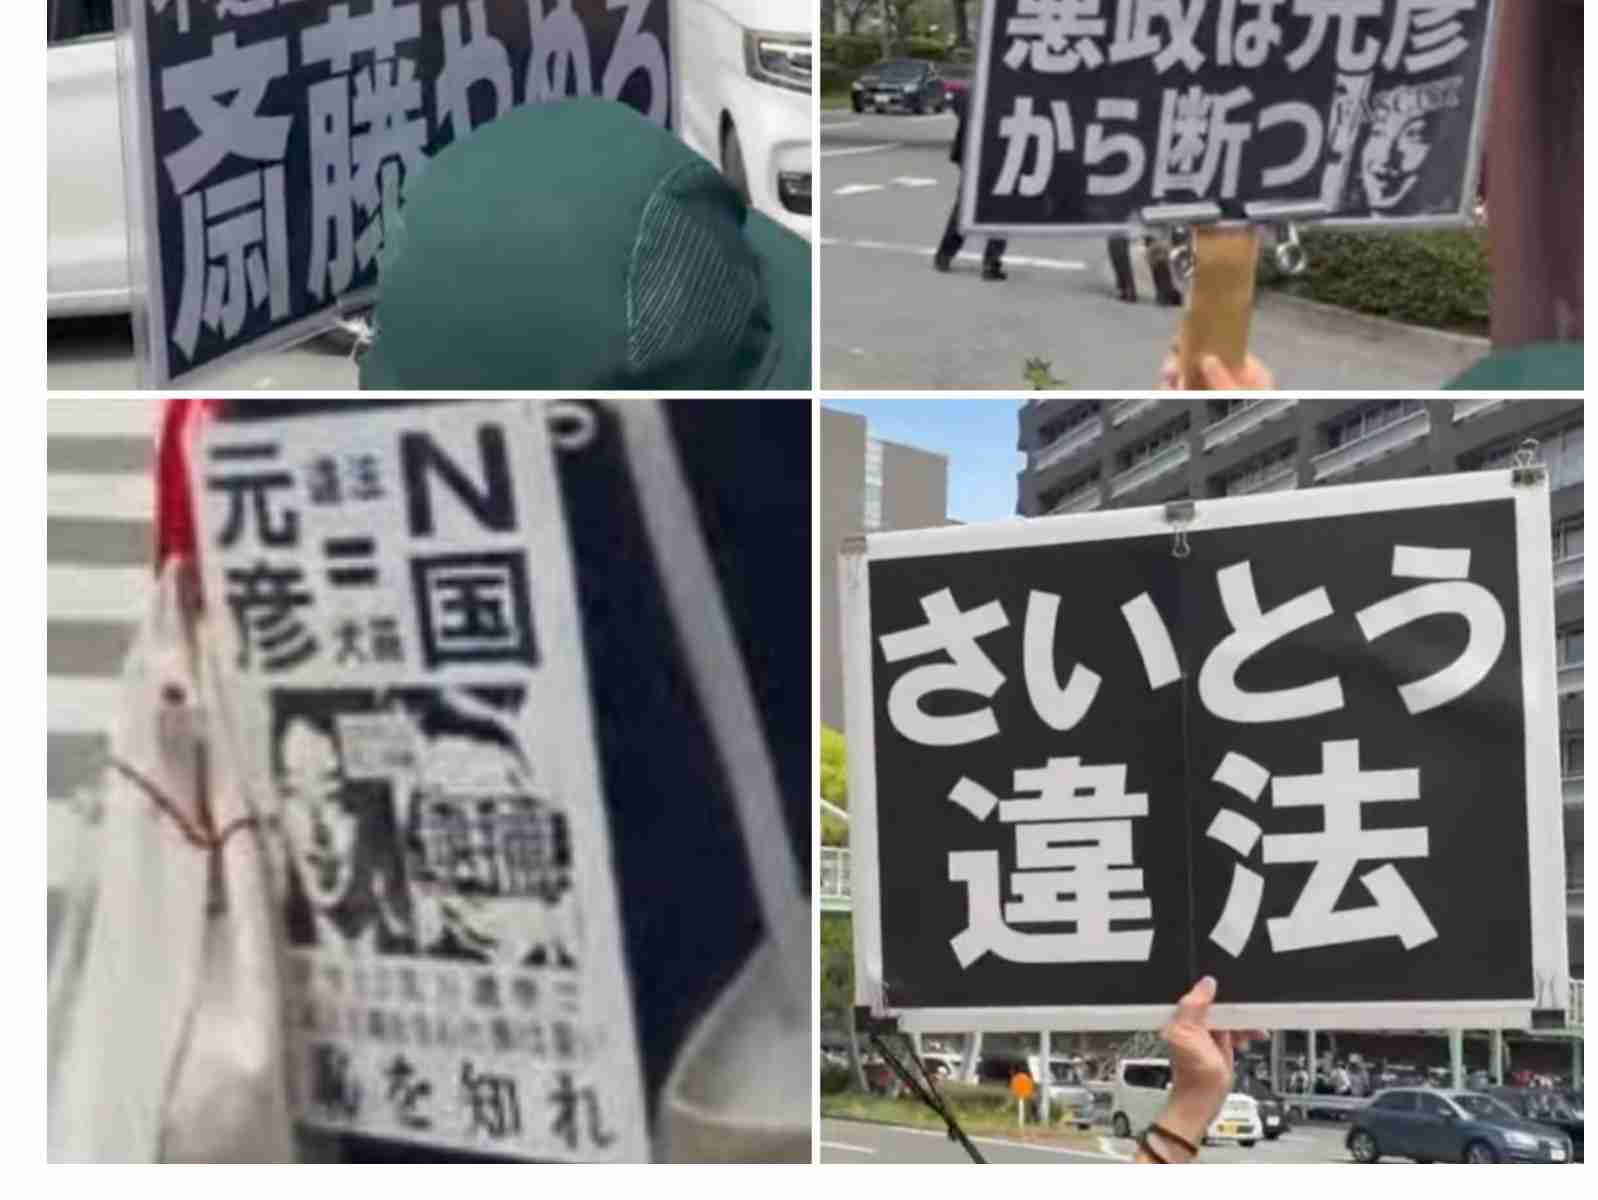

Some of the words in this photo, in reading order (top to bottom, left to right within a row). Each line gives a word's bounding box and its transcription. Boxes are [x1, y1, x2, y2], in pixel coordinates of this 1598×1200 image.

[203, 442, 320, 674] 元彦
[397, 420, 542, 670] N国
[878, 544, 1507, 746] さいとう
[947, 738, 1439, 970] 違法
